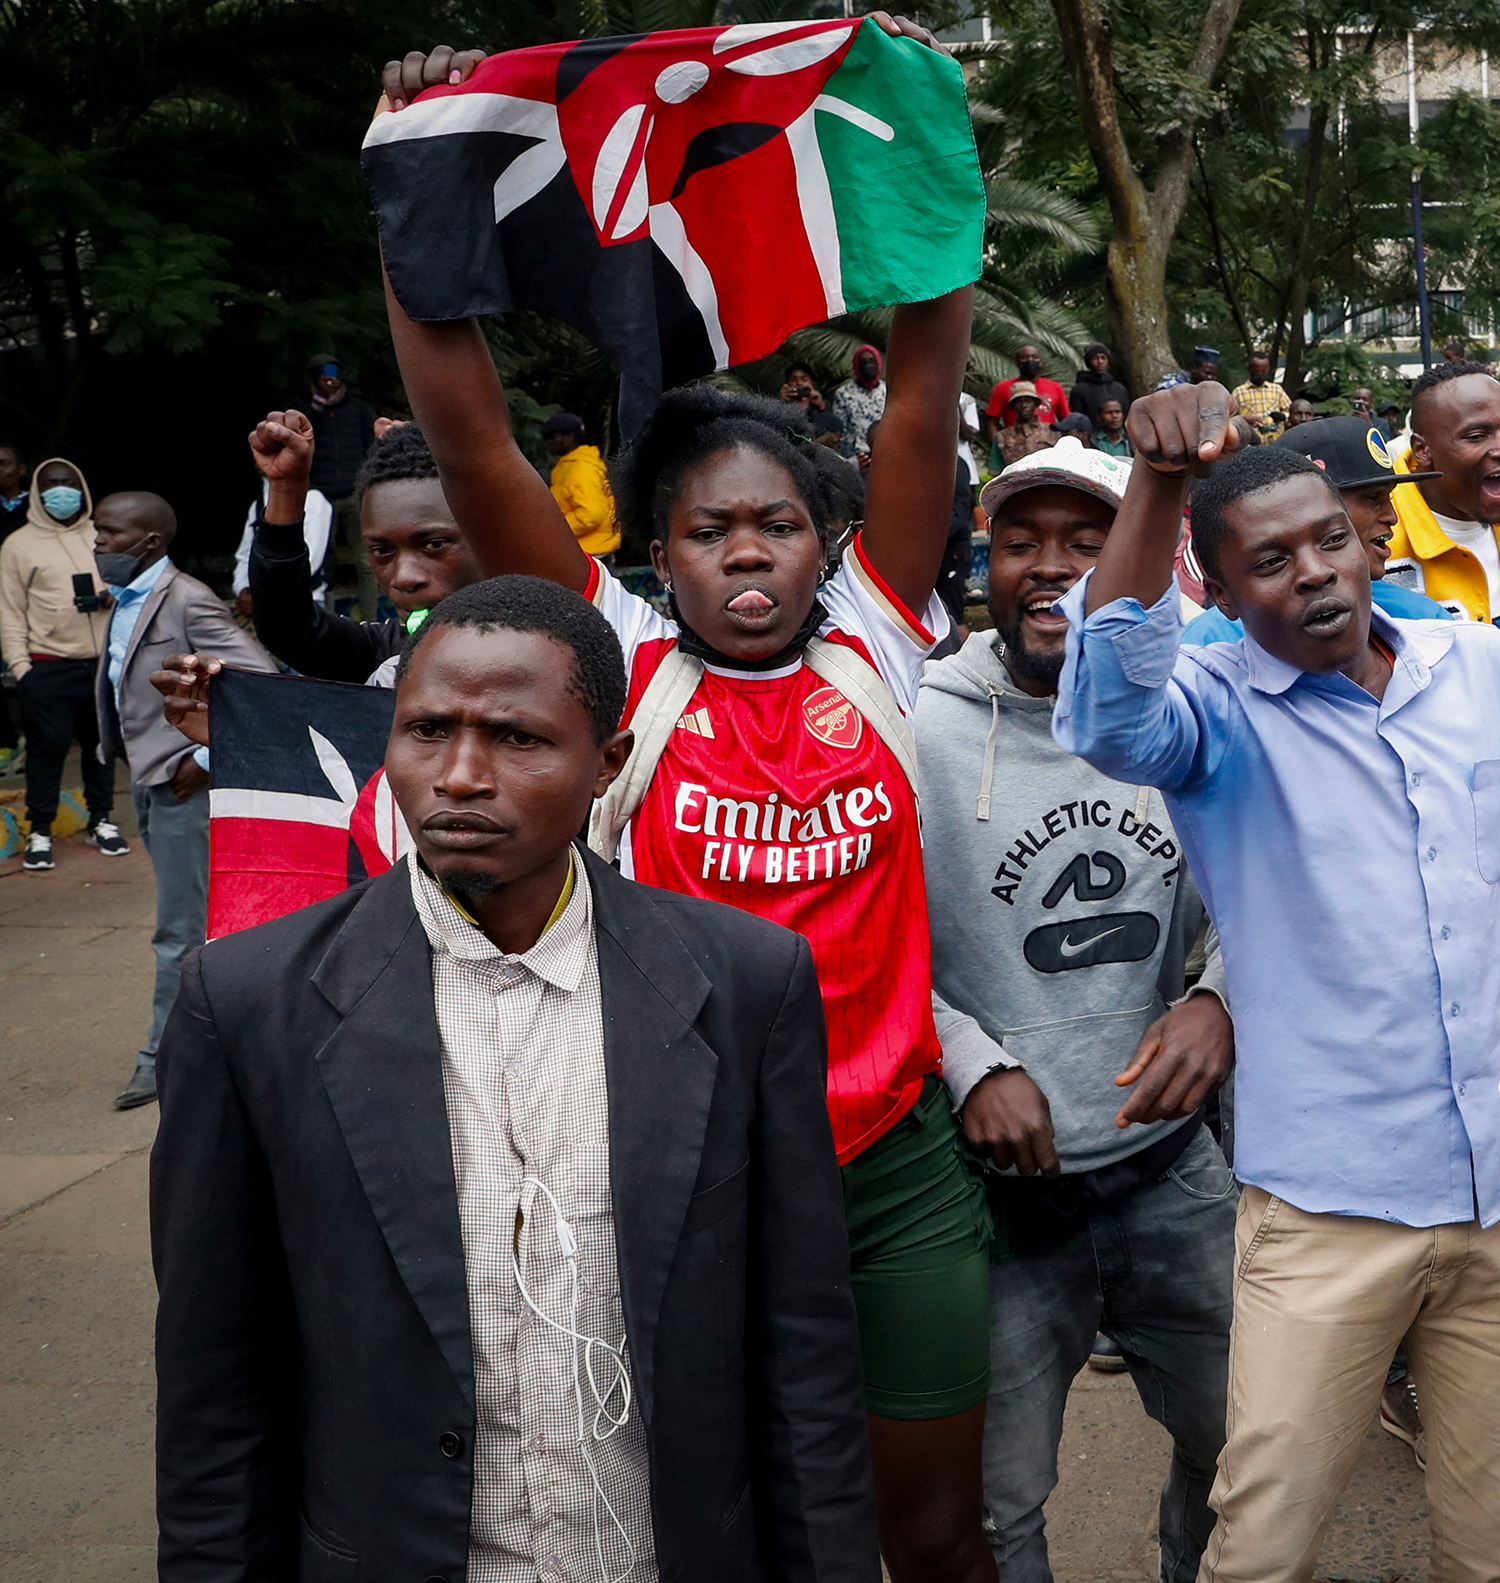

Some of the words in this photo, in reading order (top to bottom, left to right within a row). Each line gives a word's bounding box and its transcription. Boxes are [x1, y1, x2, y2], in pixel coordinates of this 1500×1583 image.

[806, 691, 844, 718] Arsenal
[674, 781, 893, 842] Emirates
[702, 840, 754, 883] FLY
[765, 832, 872, 884] BETTER
[990, 799, 1112, 906] ATHLETIC
